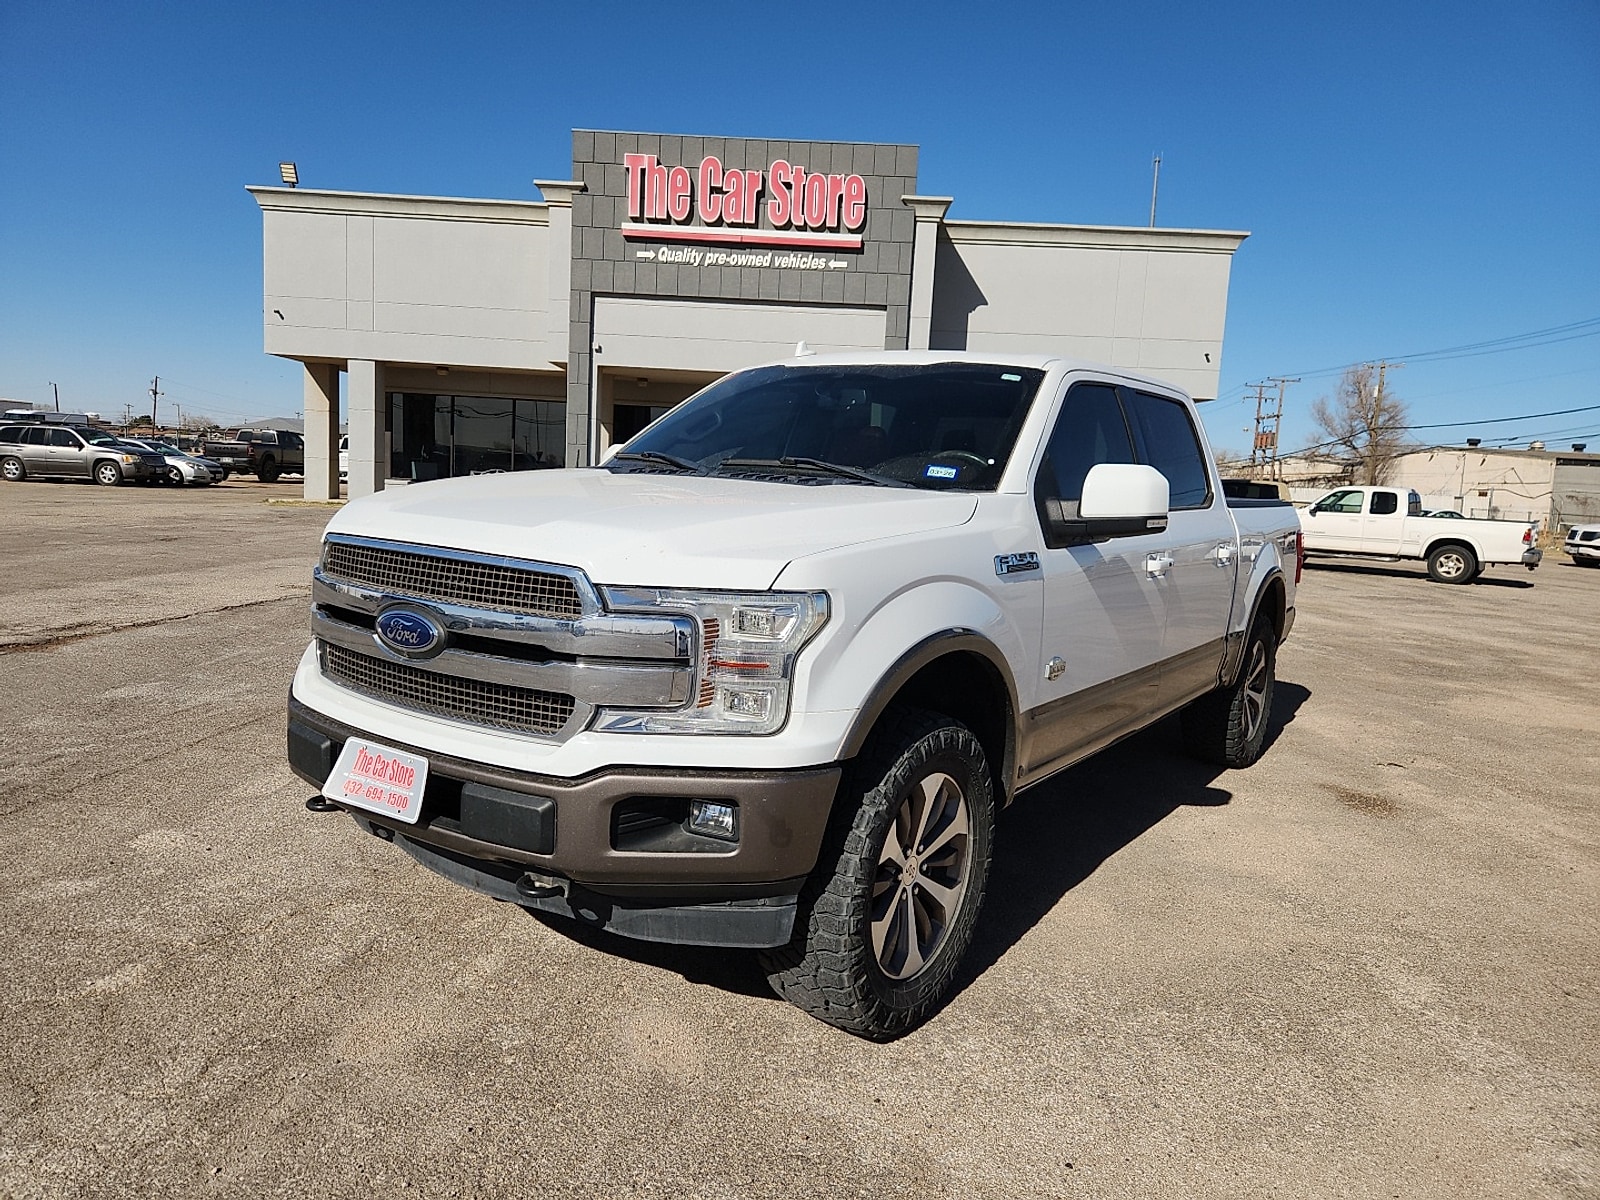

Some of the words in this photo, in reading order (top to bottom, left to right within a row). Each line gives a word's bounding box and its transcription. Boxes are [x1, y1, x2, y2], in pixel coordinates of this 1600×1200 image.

[624, 153, 691, 221] The
[699, 155, 762, 225] Car
[768, 159, 866, 229] Store
[657, 246, 703, 267] Quality
[704, 252, 773, 268] pre-owned
[774, 254, 827, 270] vehicles
[386, 617, 421, 644] Ford
[352, 747, 375, 775] The
[371, 753, 391, 780] Car
[388, 758, 415, 788] Store
[343, 780, 409, 810] 432-694-1500
